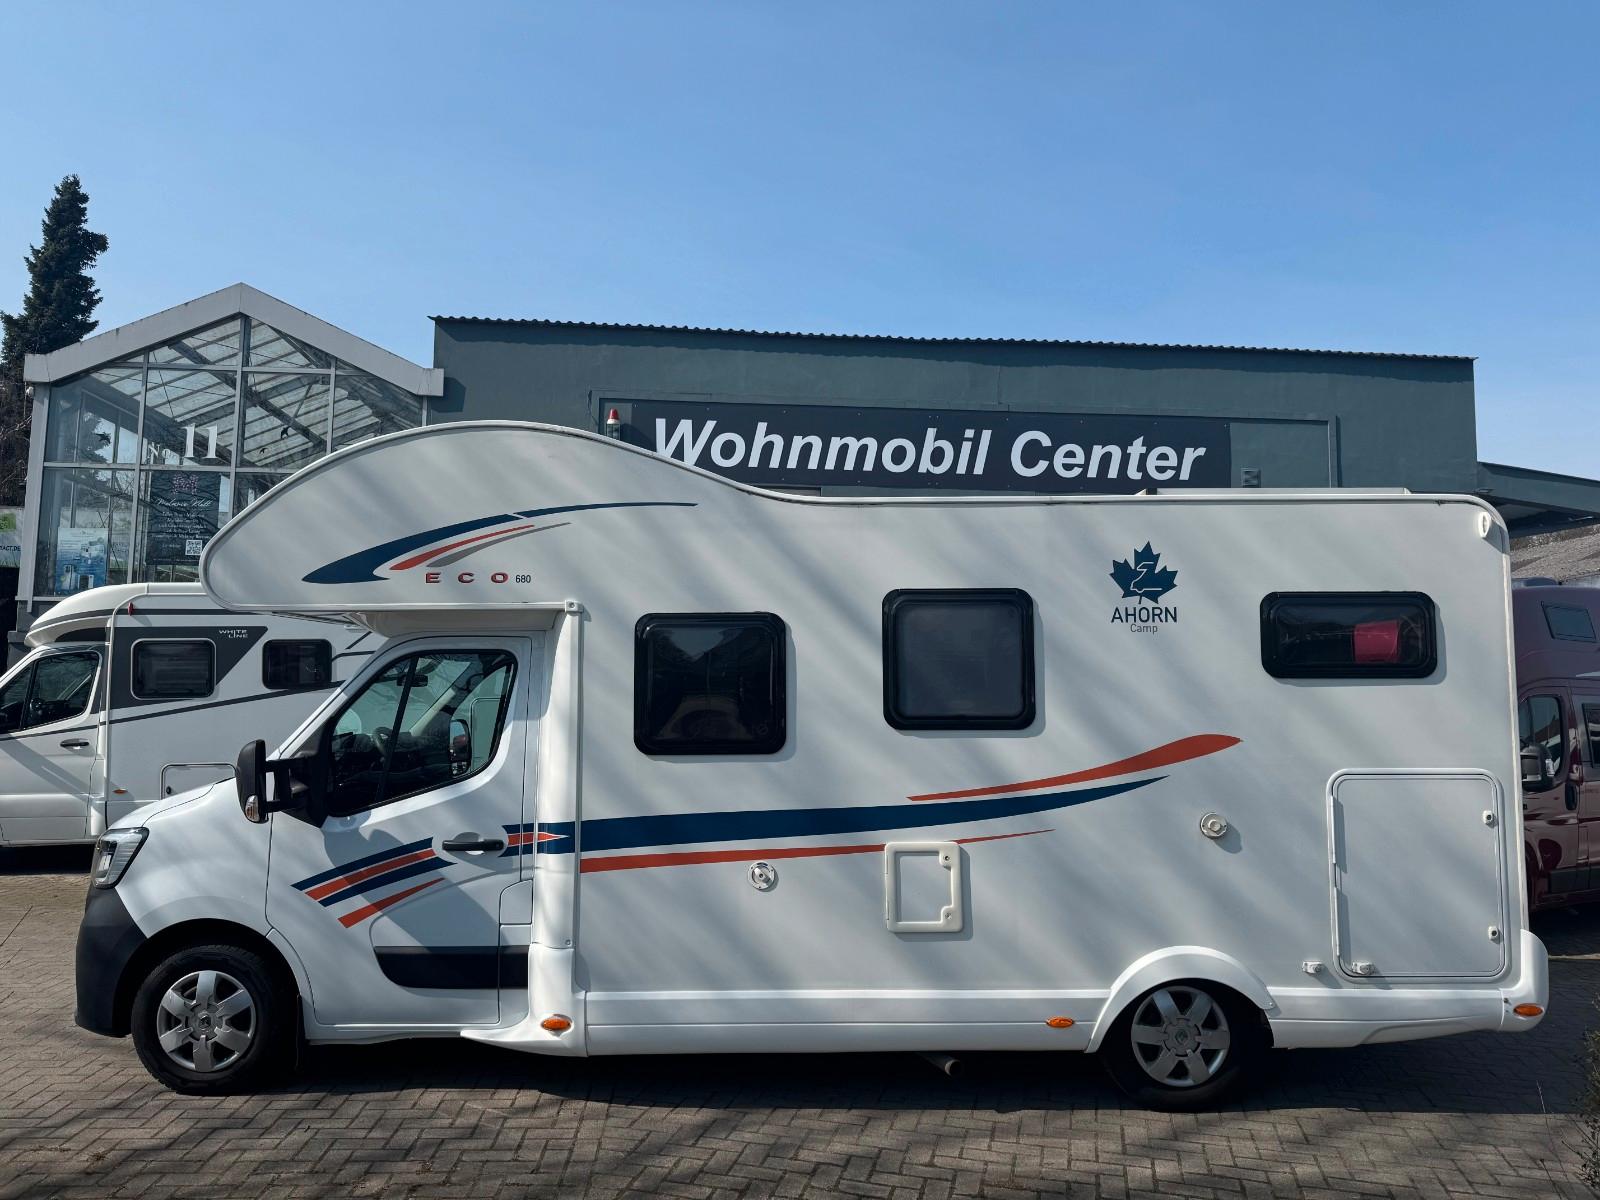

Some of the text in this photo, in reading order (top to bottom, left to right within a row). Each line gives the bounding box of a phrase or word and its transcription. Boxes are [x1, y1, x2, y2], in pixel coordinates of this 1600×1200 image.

[180, 422, 219, 459] 11
[654, 417, 1208, 481] Wohnmobil Center
[425, 571, 532, 584] ECO 680
[1110, 606, 1178, 624] AHORN
[1130, 623, 1158, 635] Camp
